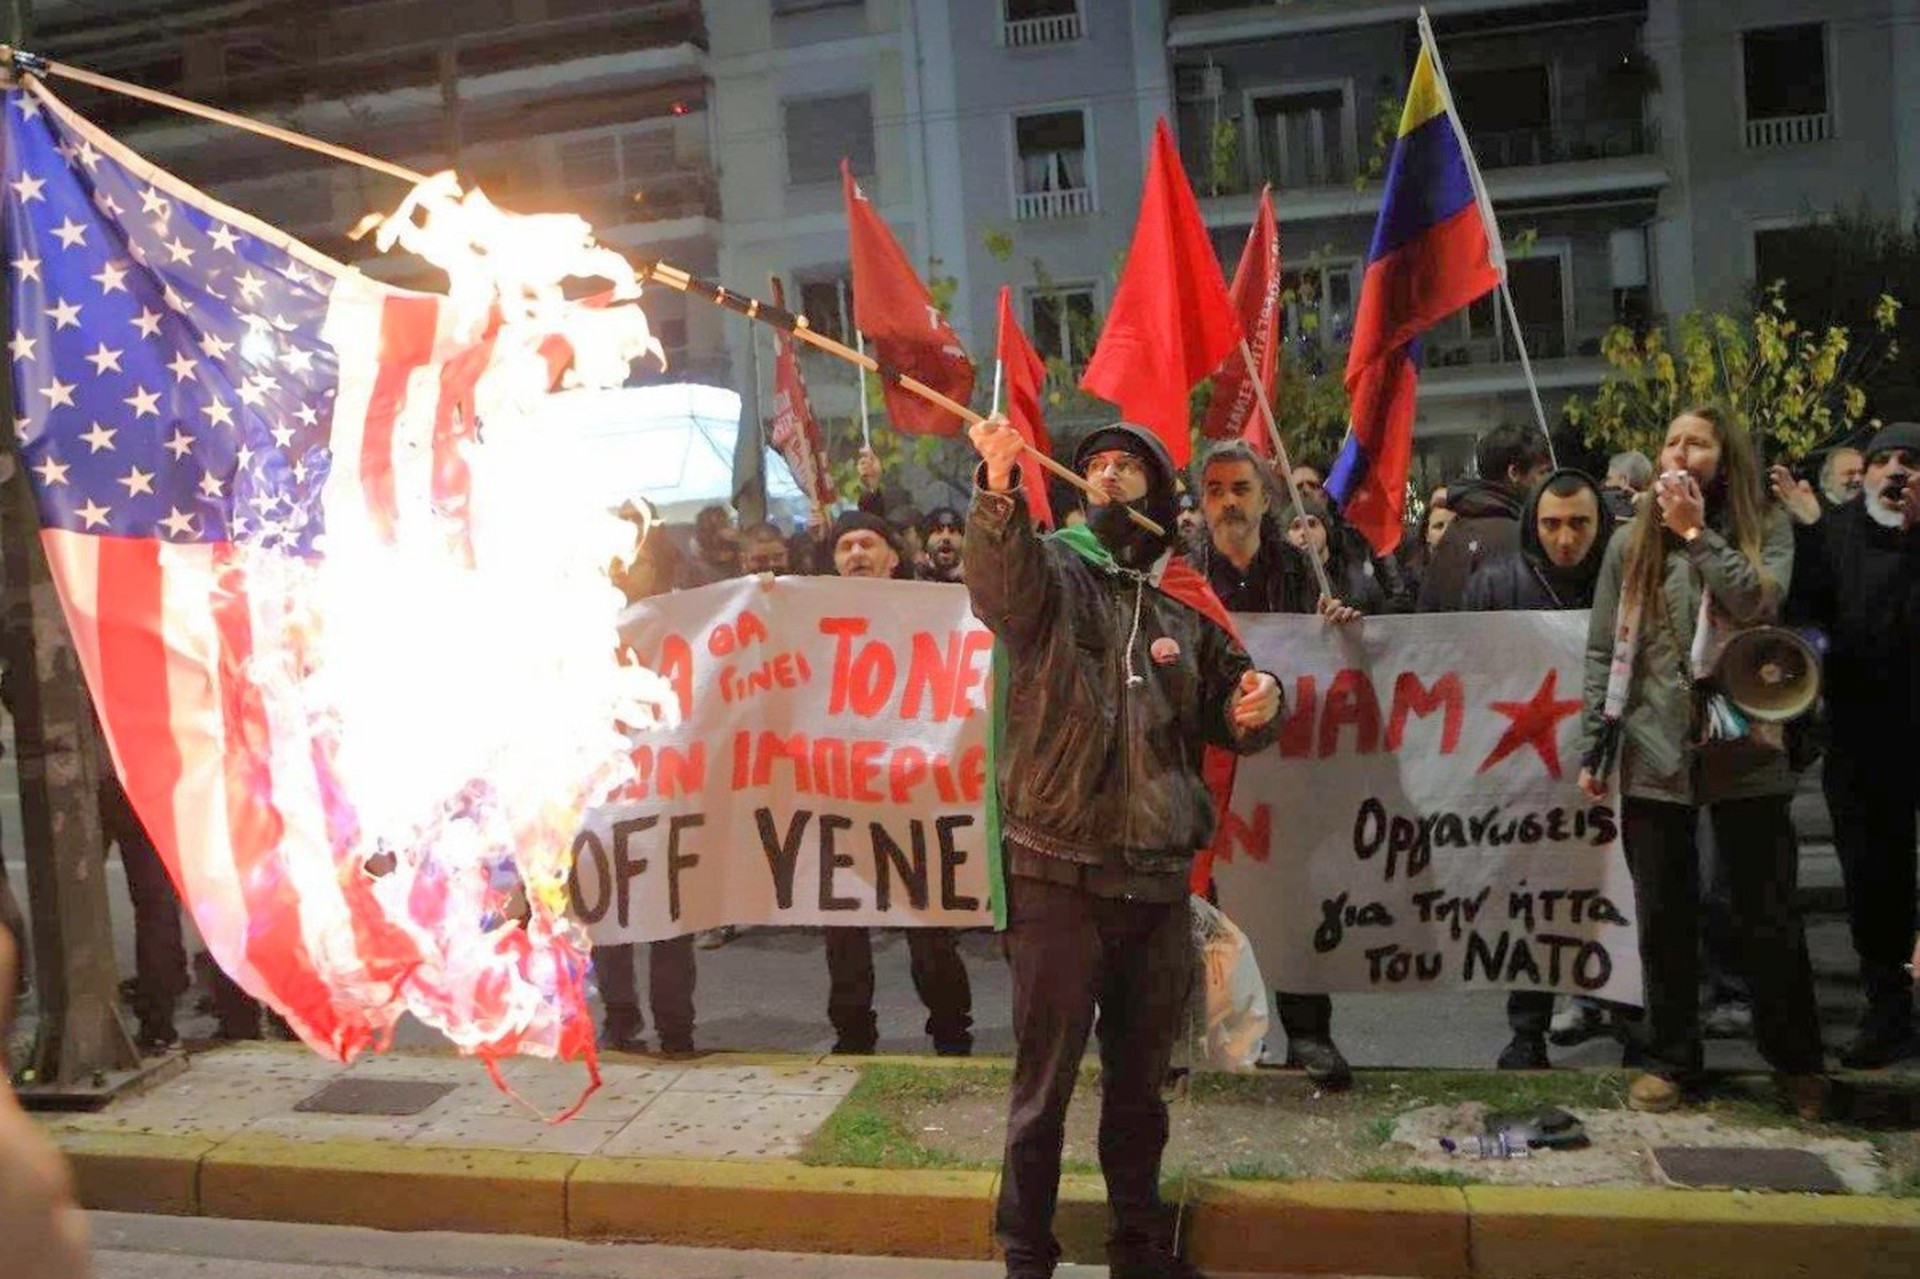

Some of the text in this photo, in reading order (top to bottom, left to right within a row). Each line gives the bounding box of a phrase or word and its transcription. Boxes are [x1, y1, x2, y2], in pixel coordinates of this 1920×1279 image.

[708, 610, 767, 657] ΘΑ
[720, 651, 812, 705] ΓΙΝΕΙ
[899, 630, 994, 723] ΝΕ
[568, 806, 994, 928] OFF VENE
